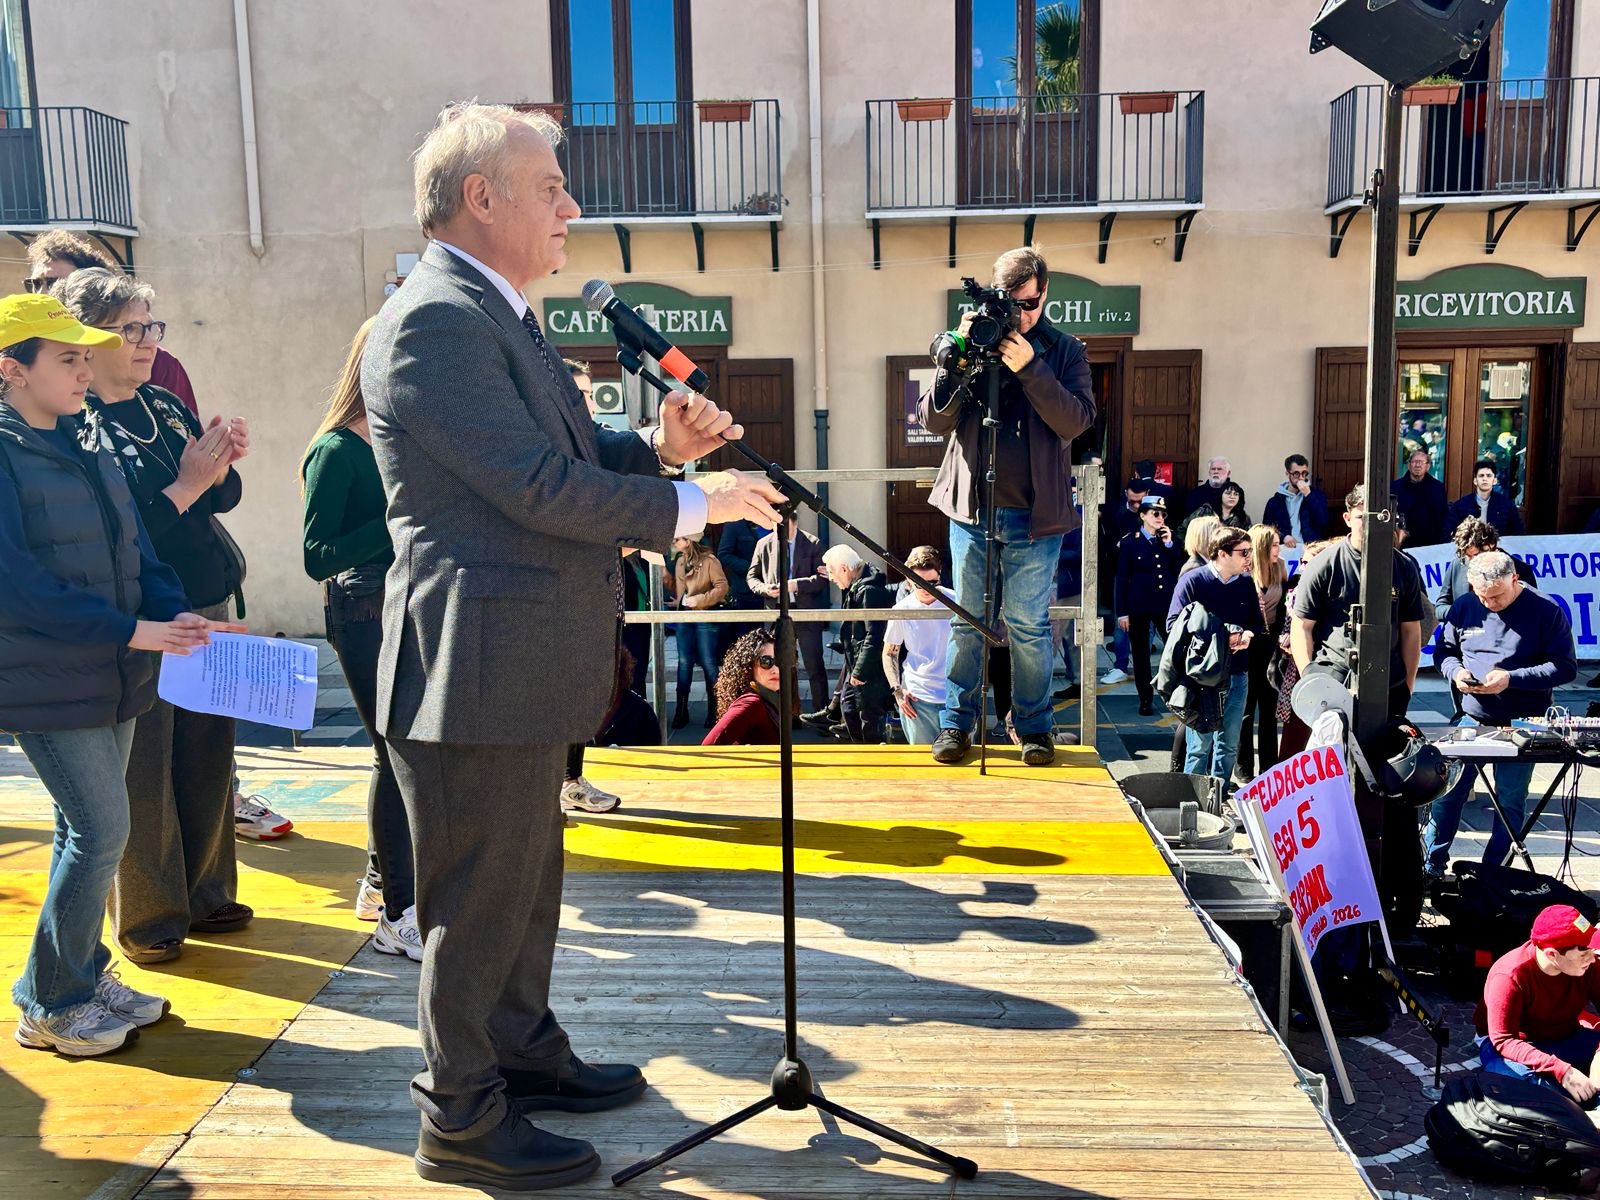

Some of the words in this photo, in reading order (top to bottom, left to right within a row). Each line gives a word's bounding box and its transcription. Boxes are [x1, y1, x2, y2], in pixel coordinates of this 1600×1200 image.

[1394, 290, 1575, 317] RICEVITORIA
[548, 309, 728, 333] CAFTERIA
[1331, 904, 1362, 925] 2026
